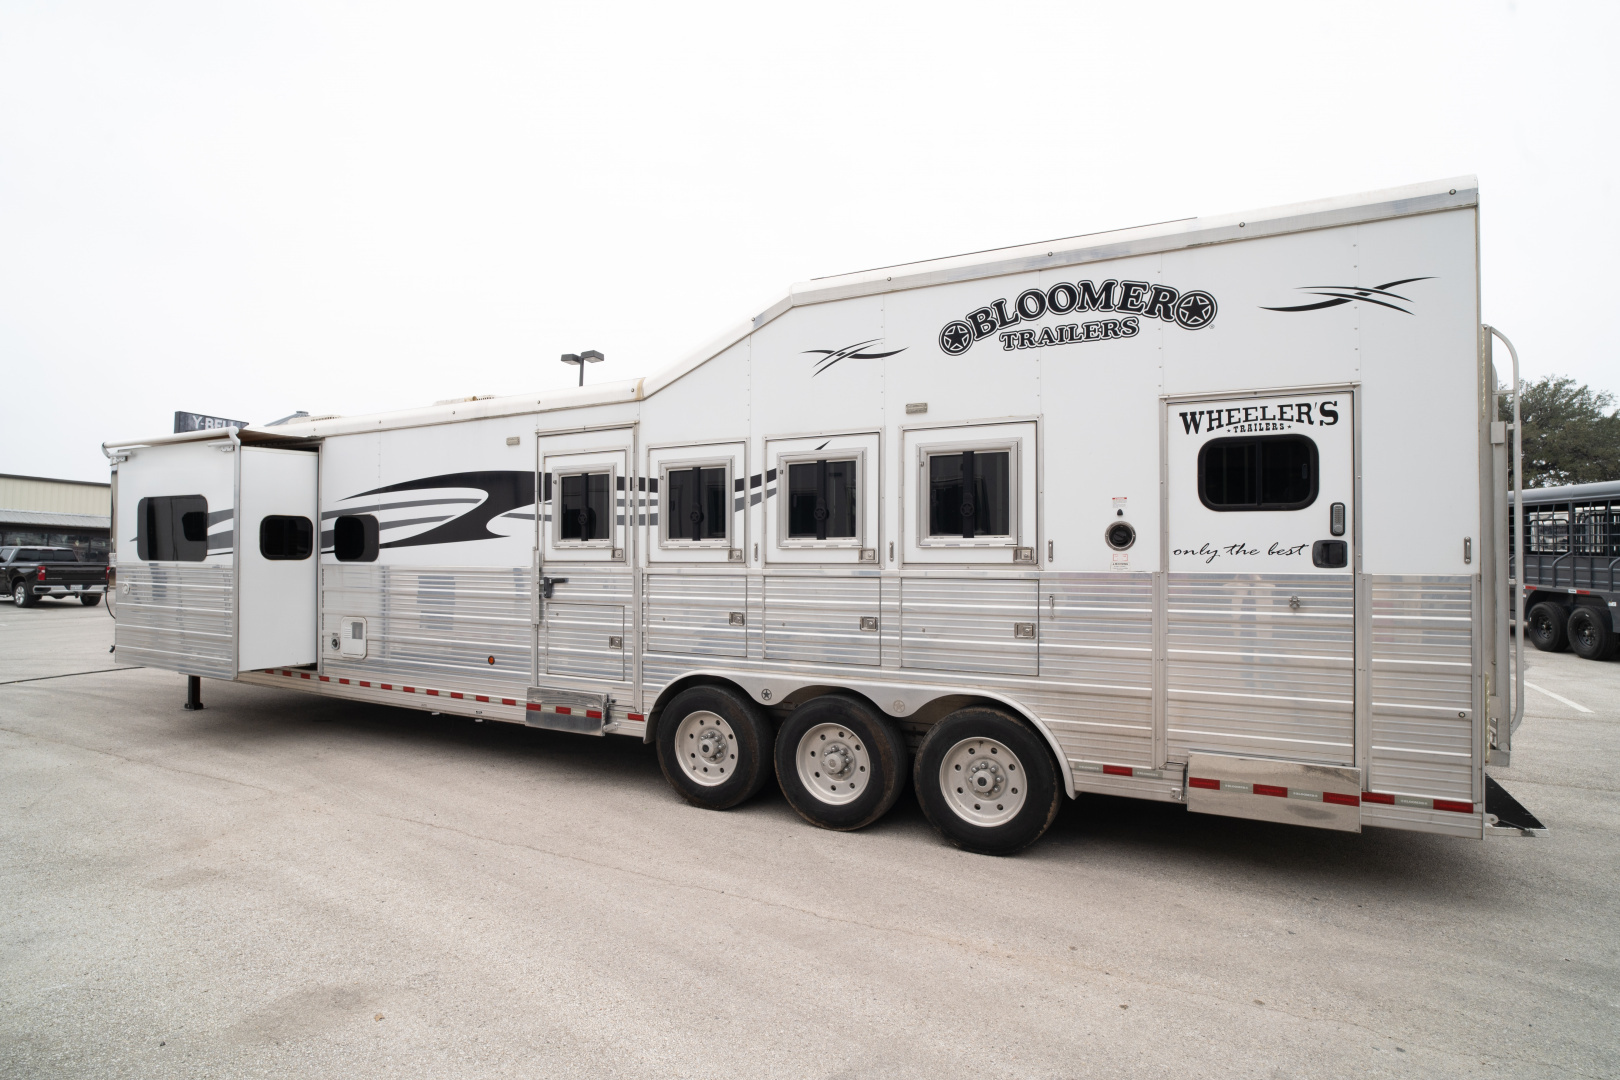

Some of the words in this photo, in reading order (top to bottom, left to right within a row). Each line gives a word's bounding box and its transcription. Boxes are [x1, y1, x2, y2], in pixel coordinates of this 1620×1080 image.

[967, 279, 1179, 341] BLOOMER
[999, 317, 1139, 351] TRAILERS
[1179, 401, 1339, 435] WHEELER'S
[1233, 422, 1285, 433] TRAILERS
[1173, 542, 1220, 564] only
[1223, 542, 1260, 556] the
[1267, 541, 1309, 556] best
